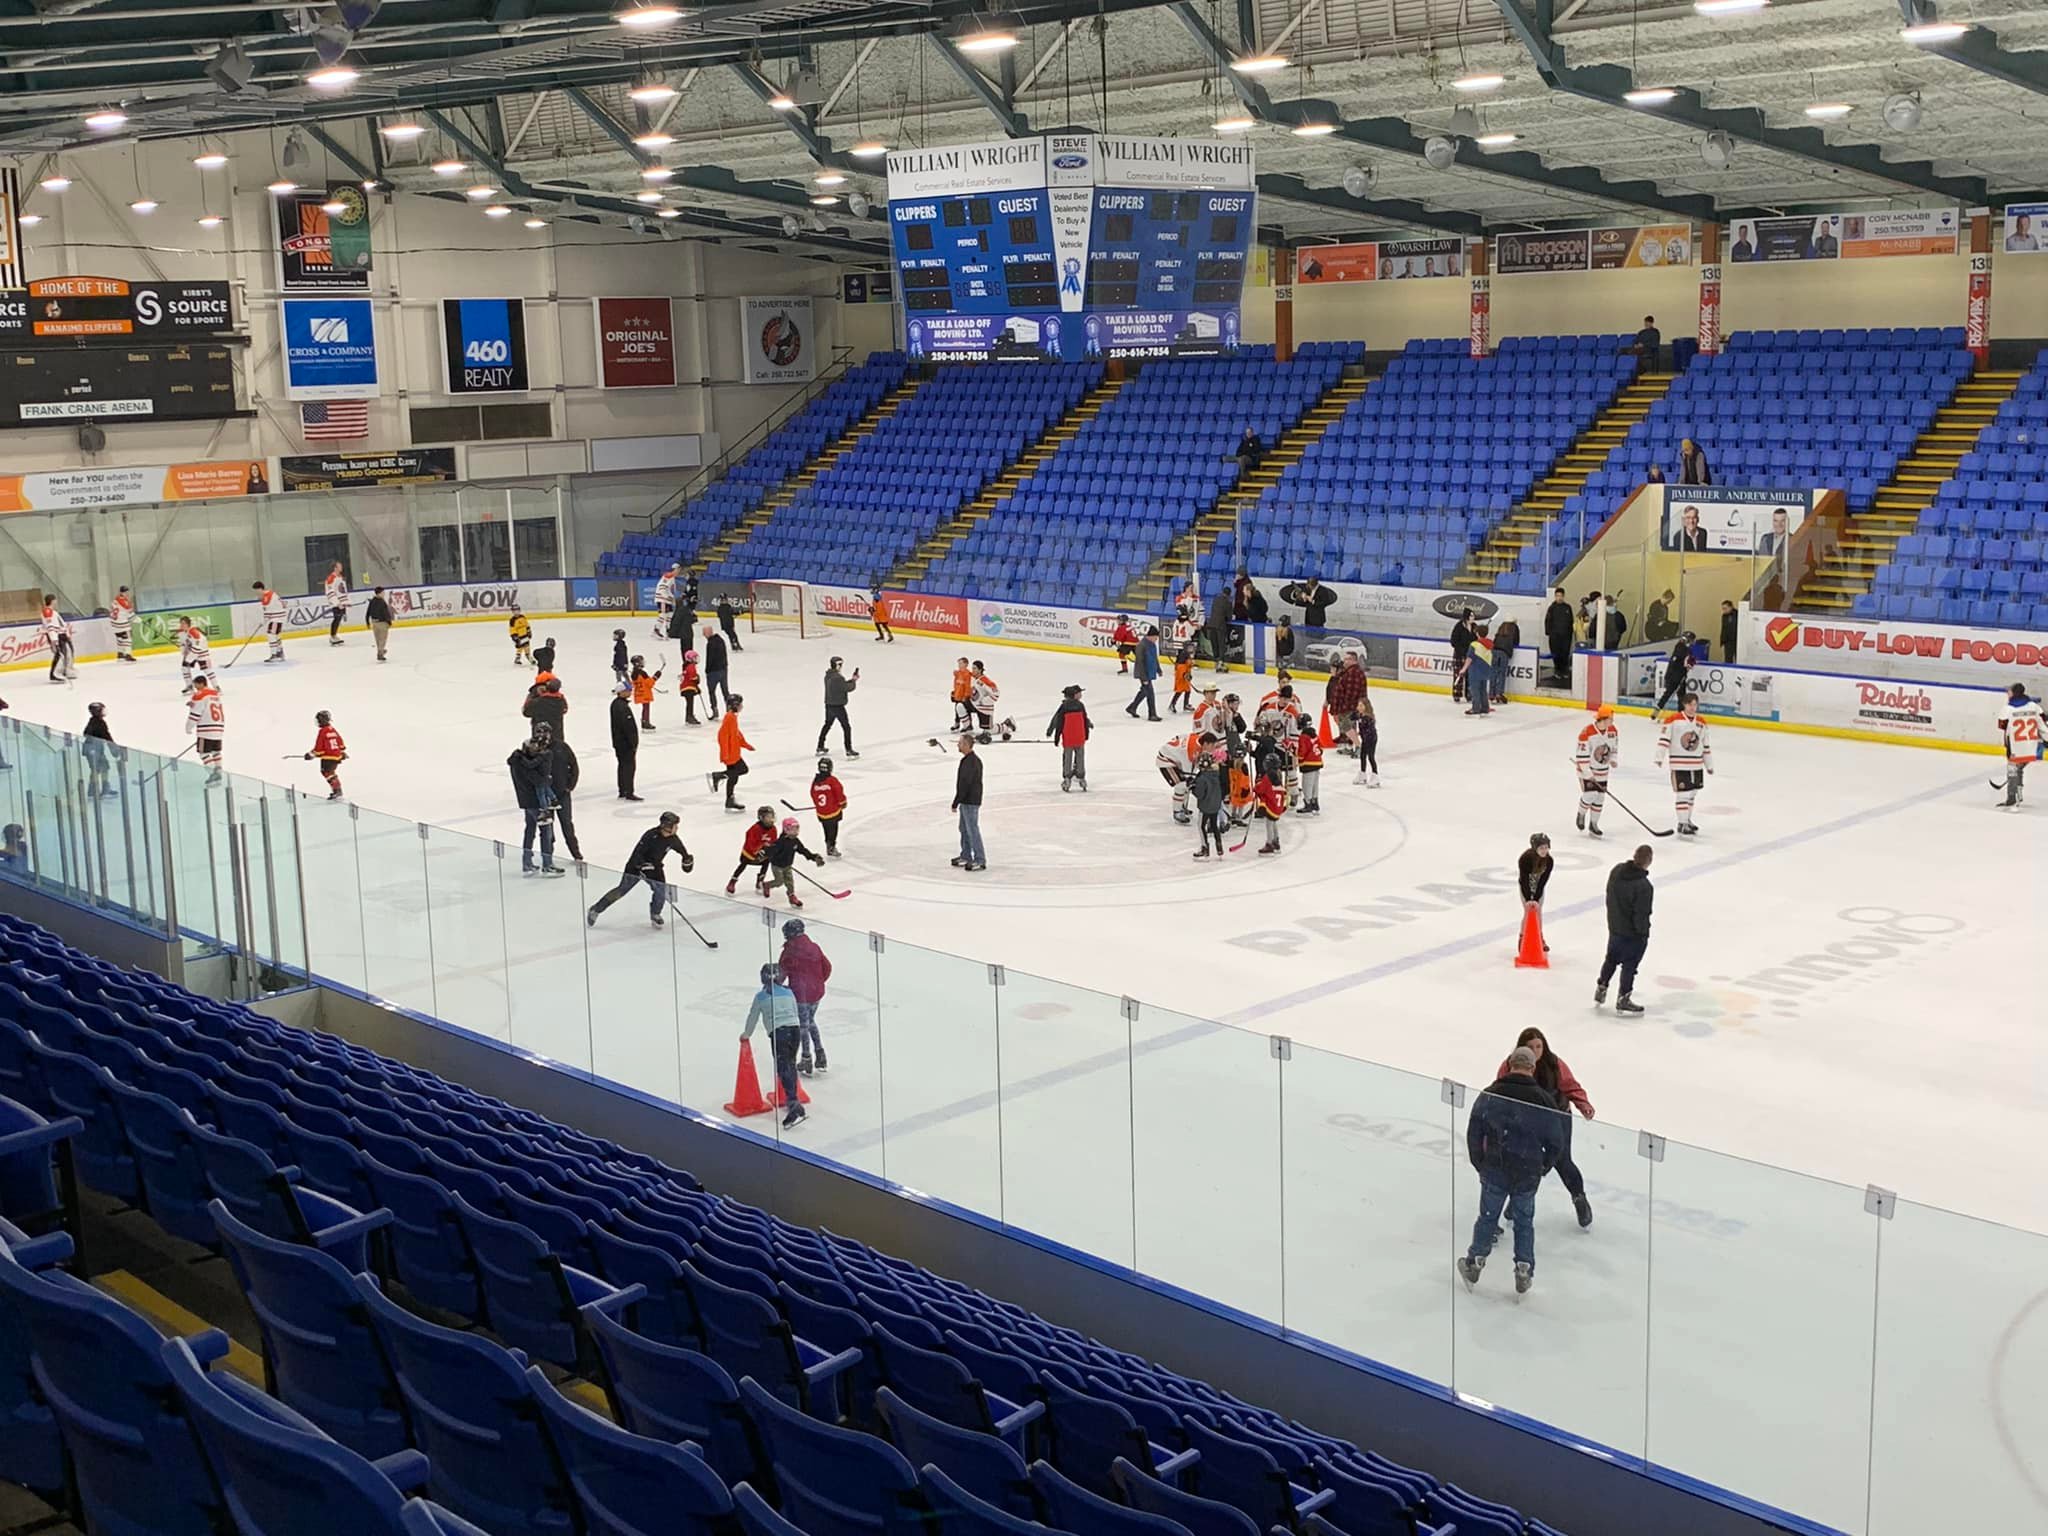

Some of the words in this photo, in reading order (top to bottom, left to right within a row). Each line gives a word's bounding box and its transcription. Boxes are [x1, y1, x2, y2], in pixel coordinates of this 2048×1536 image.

[1052, 138, 1088, 147] STEVE
[888, 152, 959, 174] WILLIAM
[971, 144, 1040, 166] WRIGHT
[1098, 141, 1176, 162] WILLIAM
[1187, 146, 1254, 165] WRIGHT
[1126, 170, 1164, 181] Commercial
[1166, 171, 1178, 181] Real
[1180, 172, 1200, 182] Estate
[1201, 173, 1226, 183] Services
[914, 180, 950, 192] Commercial
[951, 178, 966, 188] Real
[966, 178, 986, 188] Estate
[986, 176, 1012, 186] Services
[1054, 192, 1072, 200] Voted
[1073, 192, 1088, 200] Best
[998, 198, 1038, 214] GUEST
[1100, 195, 1144, 210] CLIPPERS
[1209, 198, 1246, 212] GUEST
[895, 205, 938, 221] CLIPPERS
[1868, 215, 1890, 223] CORY
[1893, 212, 1930, 221] MCNABB
[1056, 216, 1065, 224] To
[1066, 216, 1080, 226] Buy
[1080, 216, 1086, 224] A
[1400, 243, 1430, 253] WARSH
[1432, 240, 1452, 250] LAW
[1526, 239, 1586, 256] ERICKSON
[1003, 254, 1020, 264] PLYR
[1023, 252, 1052, 262] PENALTY
[1090, 252, 1108, 260] PLYR
[1112, 252, 1140, 260] PENALTY
[1218, 252, 1244, 260] PENALTY
[1525, 254, 1586, 264] ROOFING
[901, 259, 916, 268] PLYR
[920, 258, 946, 268] PENALTY
[962, 264, 988, 274] PENALTY
[1155, 260, 1182, 268] PENALTY
[1971, 257, 1986, 270] 13
[1702, 268, 1714, 280] 13
[40, 282, 74, 294] HOME
[78, 282, 92, 294] OF
[96, 282, 119, 294] THE
[1276, 289, 1284, 299] 15
[0, 303, 26, 316] RCE
[168, 300, 228, 314] SOURCE
[758, 300, 792, 308] ADVERTISE
[0, 320, 22, 328] ORTS
[174, 316, 192, 325] FOR
[193, 316, 224, 324] SPORTS
[926, 320, 946, 329] TAKE
[946, 320, 953, 328] A
[954, 319, 974, 328] LOAD
[976, 318, 992, 328] OFF
[1105, 315, 1126, 324] TAKE
[1127, 315, 1134, 324] A
[1135, 314, 1156, 324] LOAD
[1158, 314, 1174, 323] OFF
[1969, 296, 1984, 348] RE/MAX
[44, 324, 83, 334] NANAIMO
[85, 322, 122, 332] CLIPPERS
[1114, 324, 1148, 335] MOVING
[1150, 324, 1166, 334] LTD.
[1472, 311, 1482, 355] RE/MAX
[1700, 304, 1713, 350] RE/MAX
[606, 330, 668, 342] ORIGINAL
[934, 329, 966, 339] MOVING
[968, 328, 984, 338] LTD.
[288, 347, 320, 356] CROSS
[328, 346, 374, 356] COMPANY
[466, 340, 508, 362] 460
[621, 342, 656, 354] JOE'S
[1110, 347, 1170, 358] 250-616-7854
[931, 352, 988, 361] 250-616-7854
[464, 368, 514, 387] REALTY
[26, 406, 62, 416] FRANK
[68, 404, 108, 414] CRANE
[112, 402, 149, 413] ARENA
[49, 476, 70, 485] Here
[72, 475, 84, 484] for
[86, 474, 104, 484] YOU
[106, 474, 128, 482] when
[130, 472, 144, 481] the
[364, 468, 404, 477] GOODMAN
[50, 484, 101, 496] Government
[102, 484, 111, 494] is
[112, 482, 142, 492] offside
[1672, 490, 1686, 500] JIM
[1687, 490, 1720, 500] MILLER
[1726, 490, 1768, 501] ANDREW
[1770, 492, 1804, 502] MILLER
[462, 590, 518, 609] NOW
[576, 597, 596, 607] 460
[600, 596, 630, 607] REALTY
[1360, 592, 1382, 602] Family
[1382, 593, 1408, 603] Owned
[427, 602, 452, 612] 106.9
[888, 600, 912, 620] Tim
[913, 600, 960, 626] Hortons
[1355, 602, 1378, 612] Locally
[1379, 603, 1414, 614] Fabricated
[1004, 608, 1028, 617] ISLAND
[1028, 610, 1056, 620] HEIGHTS
[1004, 616, 1056, 629] CONSTRUCTION
[1056, 620, 1068, 630] LTD
[1174, 626, 1186, 638] 14
[1804, 626, 1945, 658] BUY-LOW
[1507, 666, 1533, 679] KES
[1856, 682, 1932, 713] Ricky's
[1902, 715, 1929, 723] GRILL
[2012, 718, 2038, 742] 22
[818, 794, 827, 806] 3
[1274, 794, 1282, 808] 7
[1736, 906, 1966, 998] innov8
